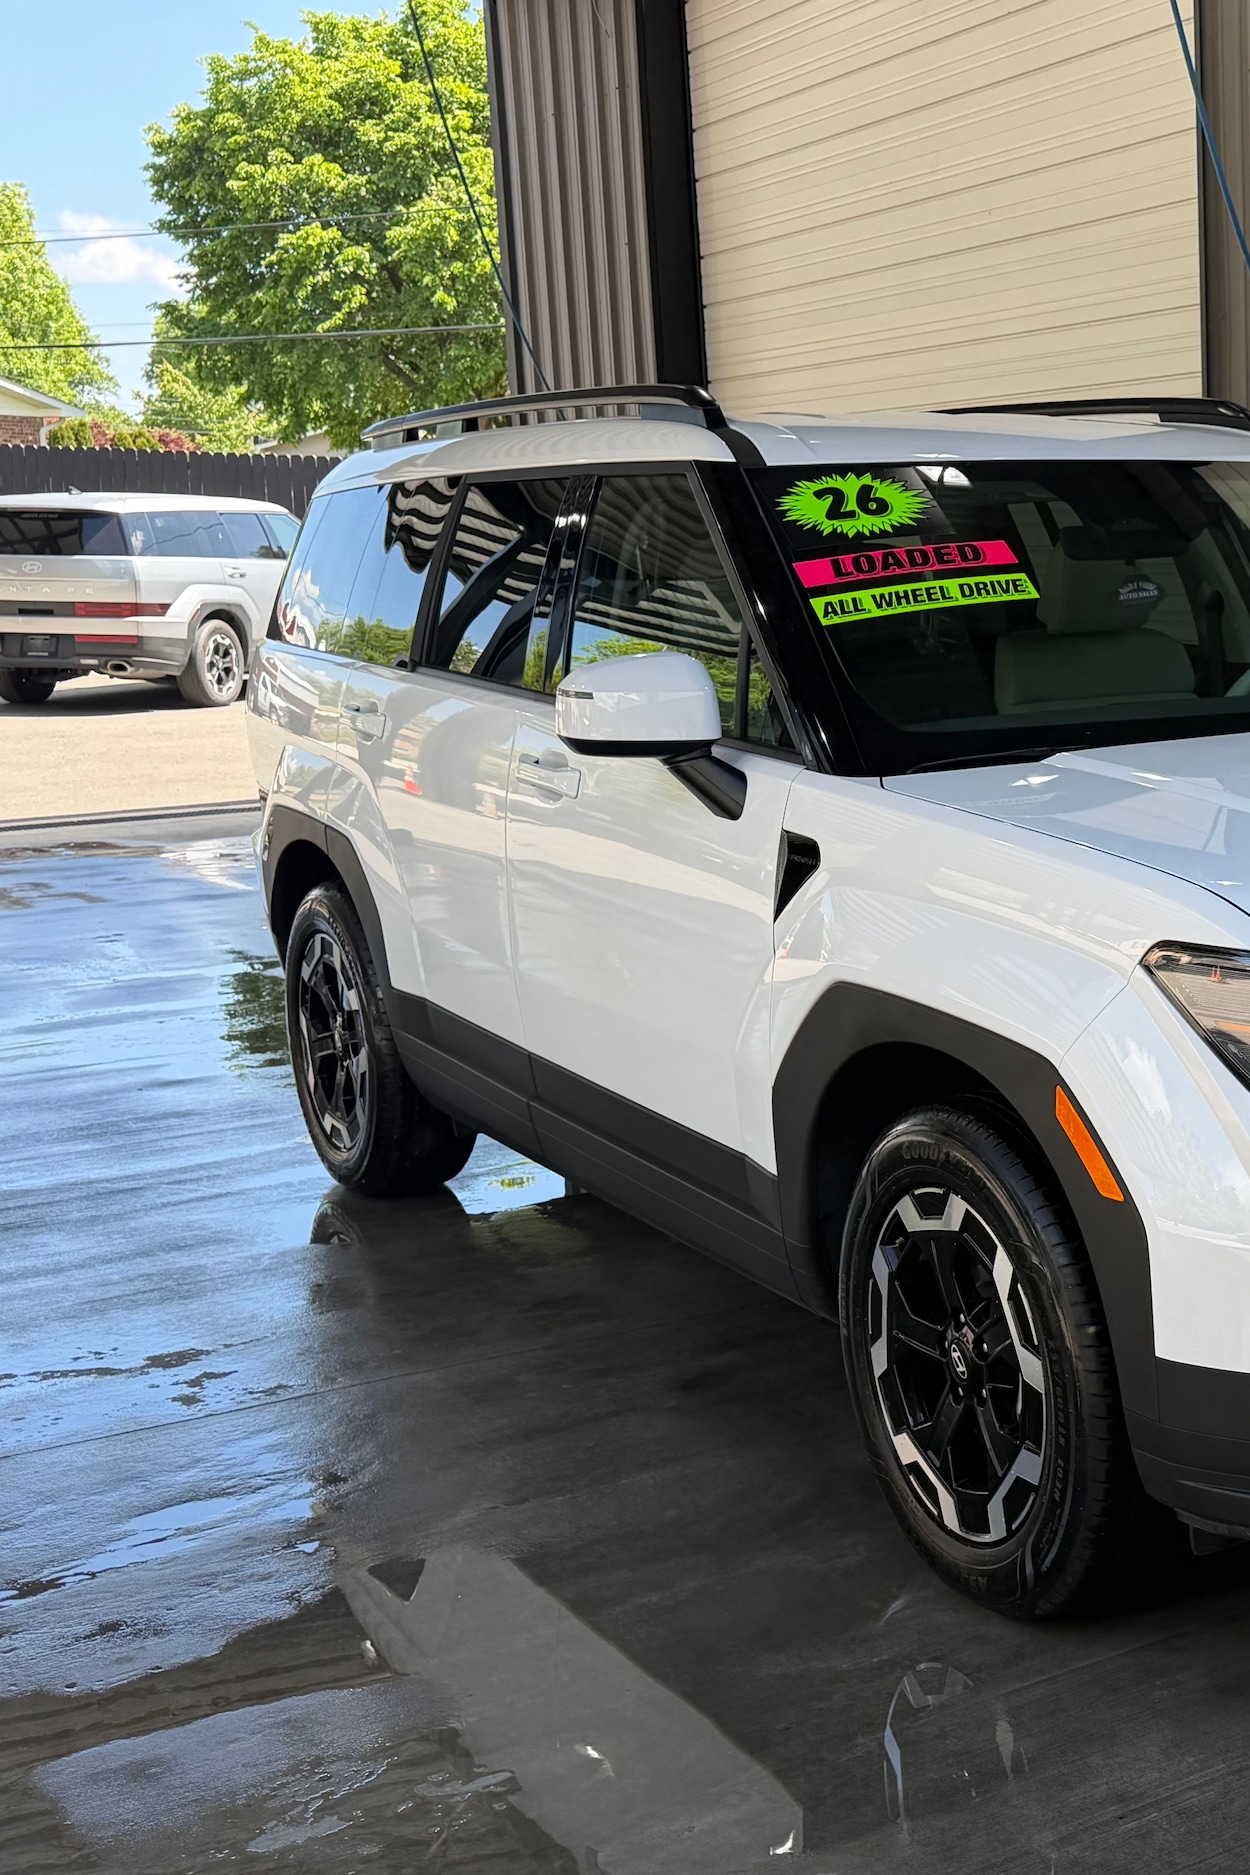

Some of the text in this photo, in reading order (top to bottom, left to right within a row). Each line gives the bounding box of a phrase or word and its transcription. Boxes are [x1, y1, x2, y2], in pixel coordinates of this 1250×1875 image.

[812, 484, 893, 522] 26
[830, 543, 986, 580] LOADED
[0, 586, 51, 594] NTA
[822, 578, 1030, 620] ALL WHEEL DRIVE
[1119, 590, 1158, 600] AUTO SALES
